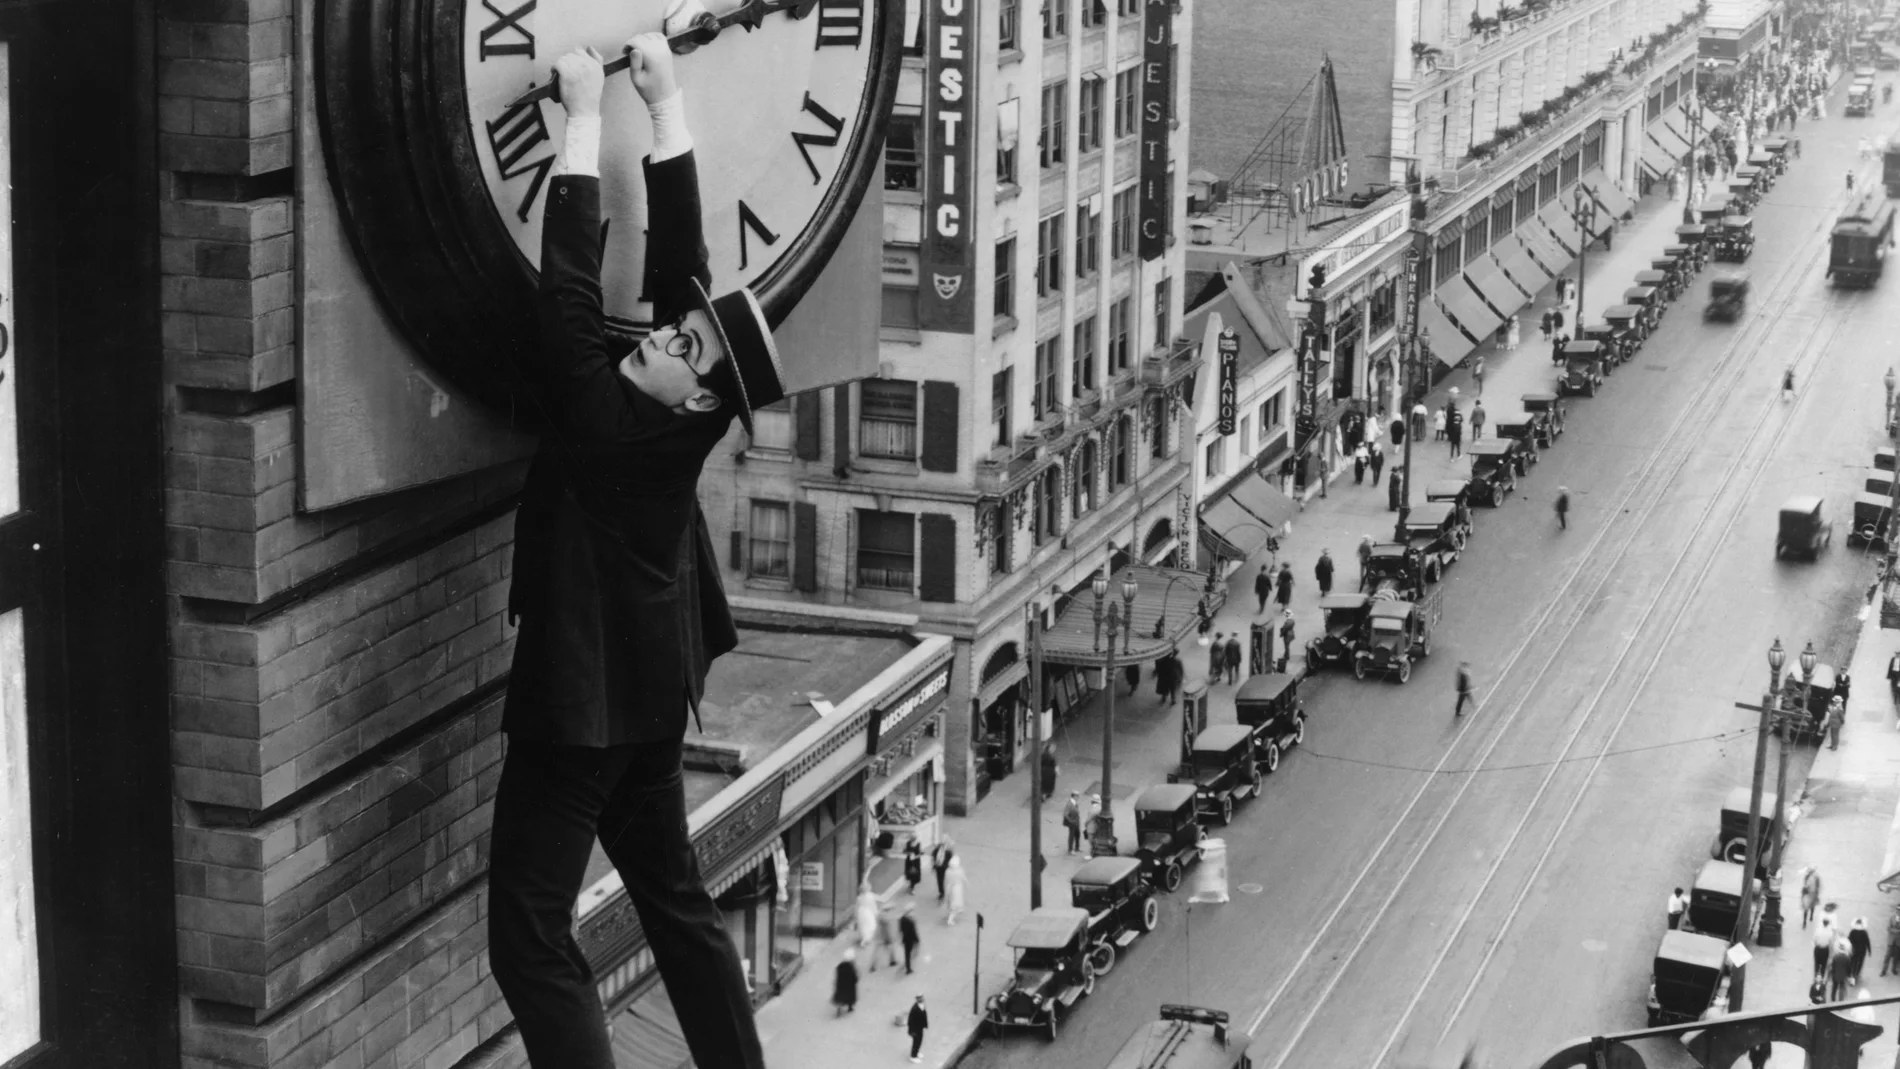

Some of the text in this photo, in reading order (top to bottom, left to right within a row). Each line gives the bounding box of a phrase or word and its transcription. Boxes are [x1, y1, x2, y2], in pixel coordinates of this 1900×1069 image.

[791, 90, 846, 186] IV
[1142, 0, 1165, 240] JESTIC
[738, 199, 780, 271] V
[1221, 352, 1234, 432] PIANOS
